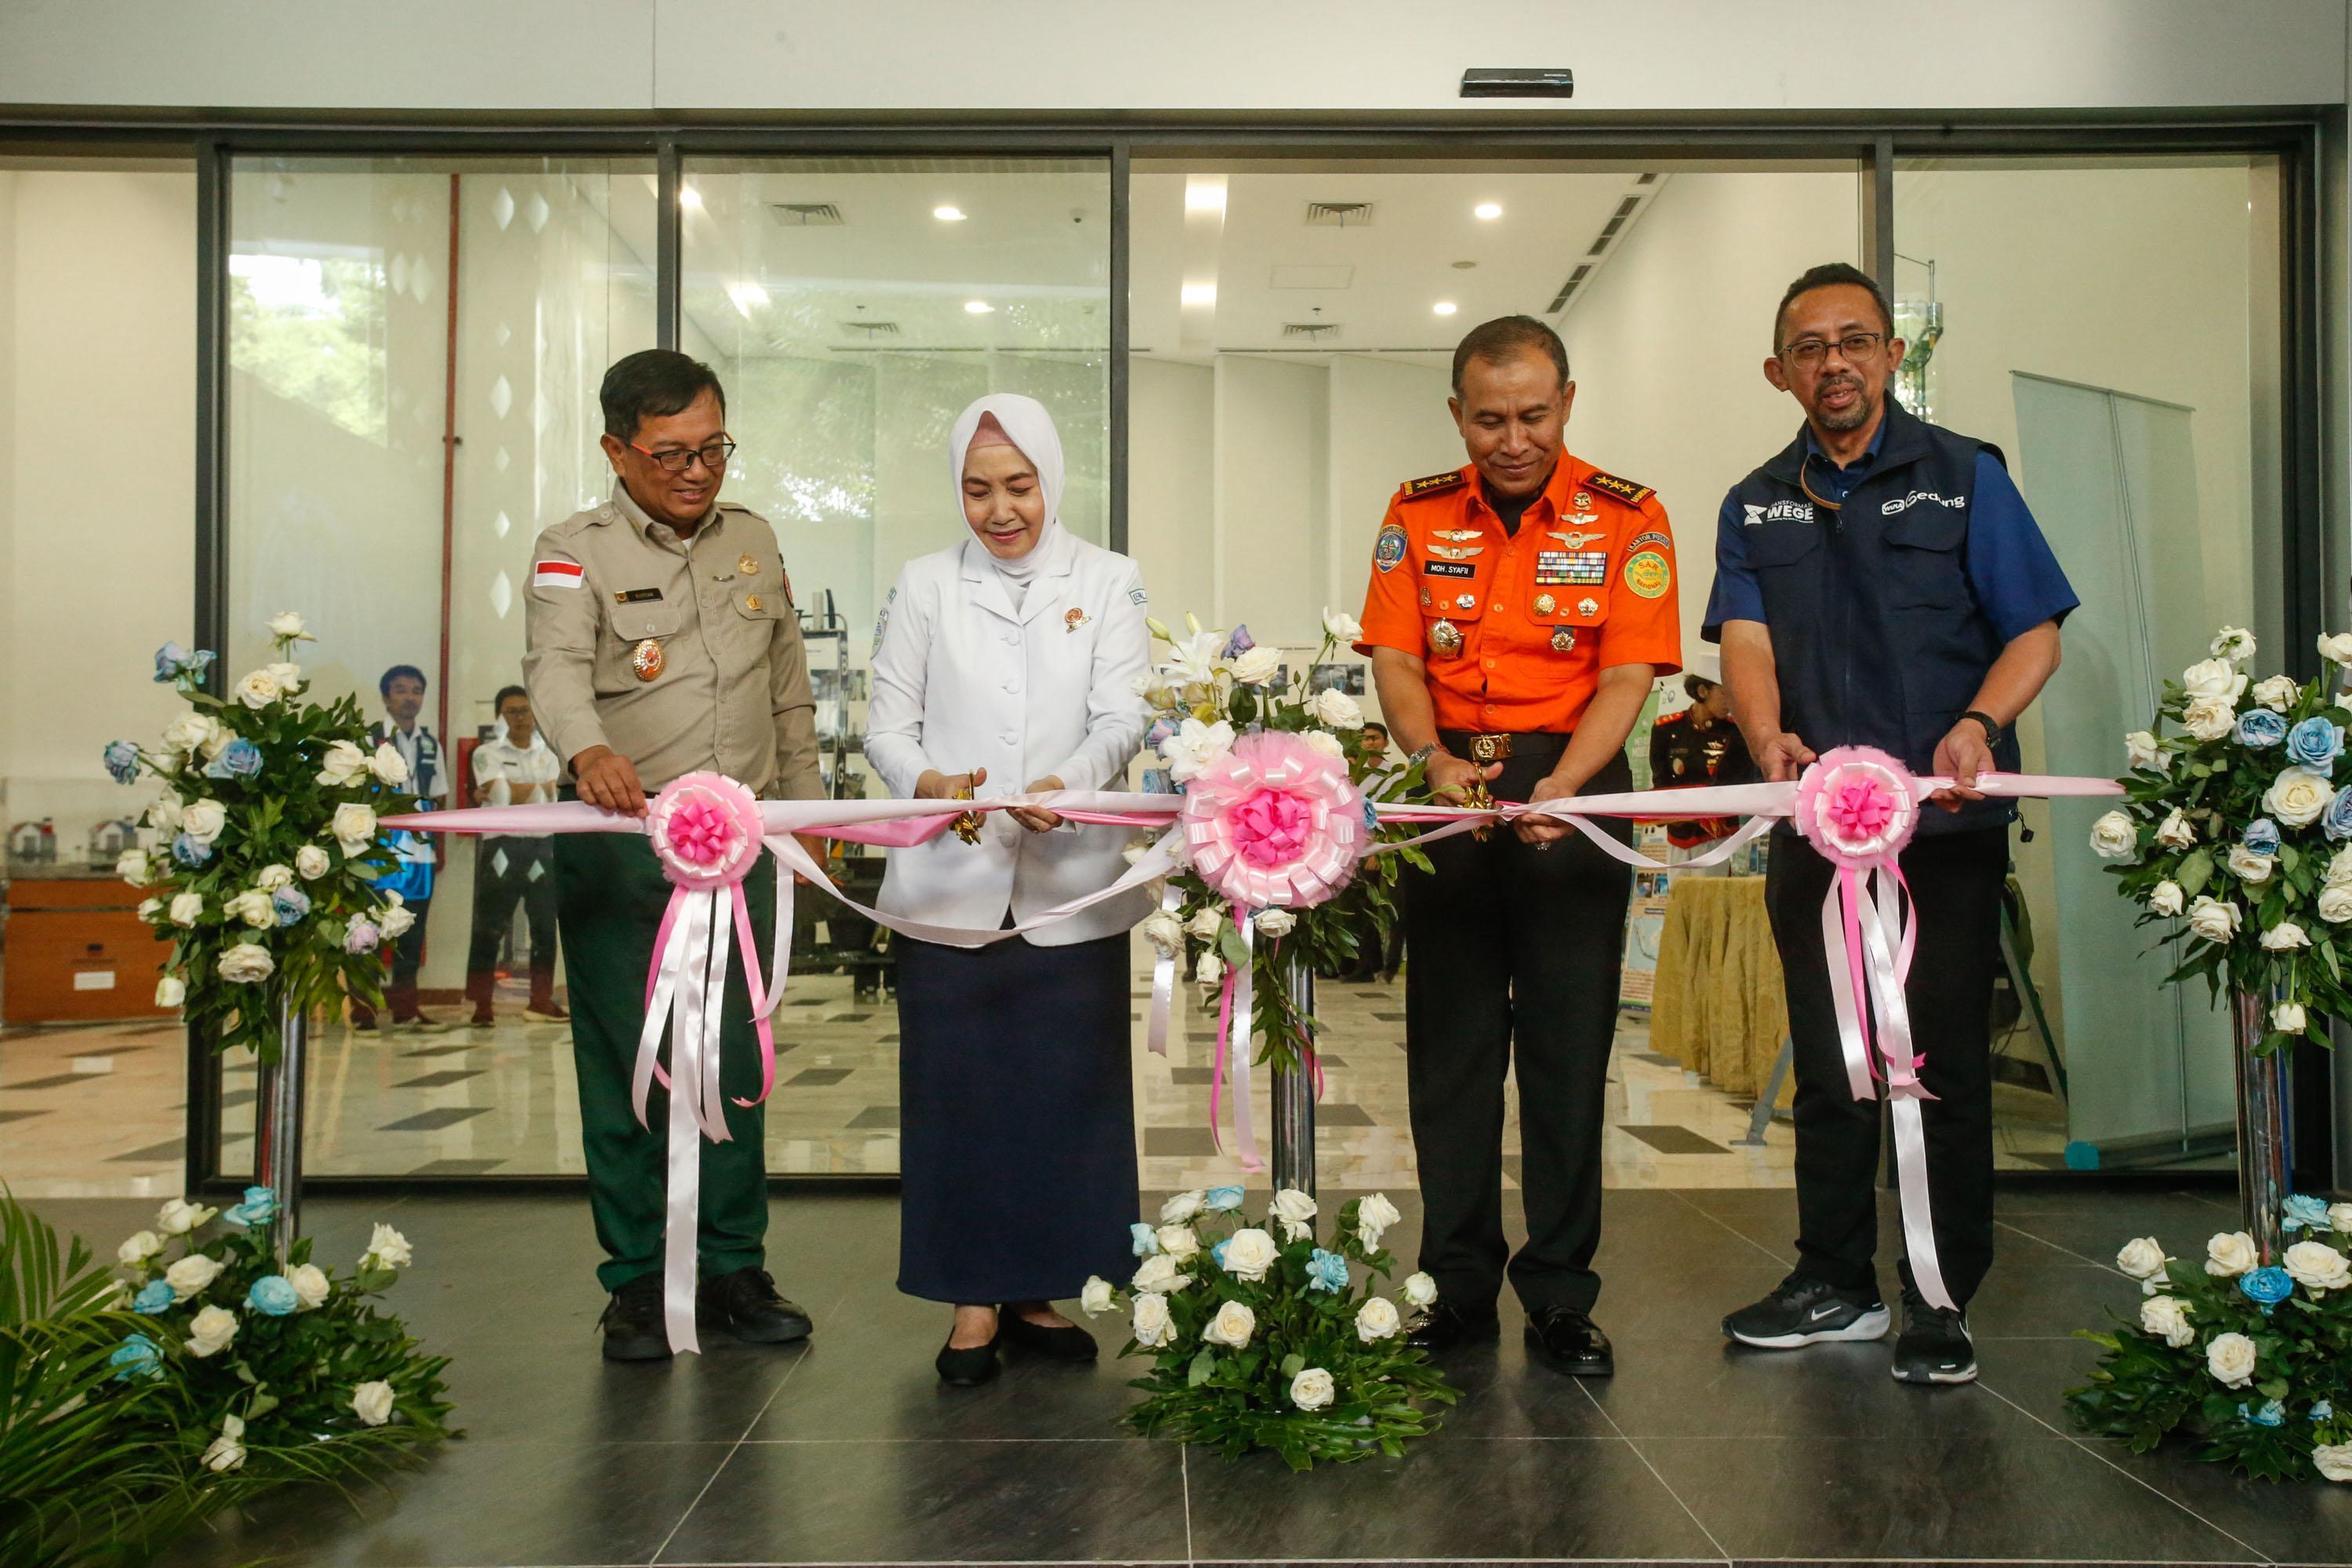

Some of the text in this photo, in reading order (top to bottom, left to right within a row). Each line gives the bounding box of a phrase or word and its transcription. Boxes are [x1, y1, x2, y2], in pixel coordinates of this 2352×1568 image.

[1906, 490, 1965, 508] Gedung
[1767, 505, 1813, 520] WEGE
[1629, 534, 1651, 550] KANTOR
[1636, 579, 1662, 590] NASIONAL
